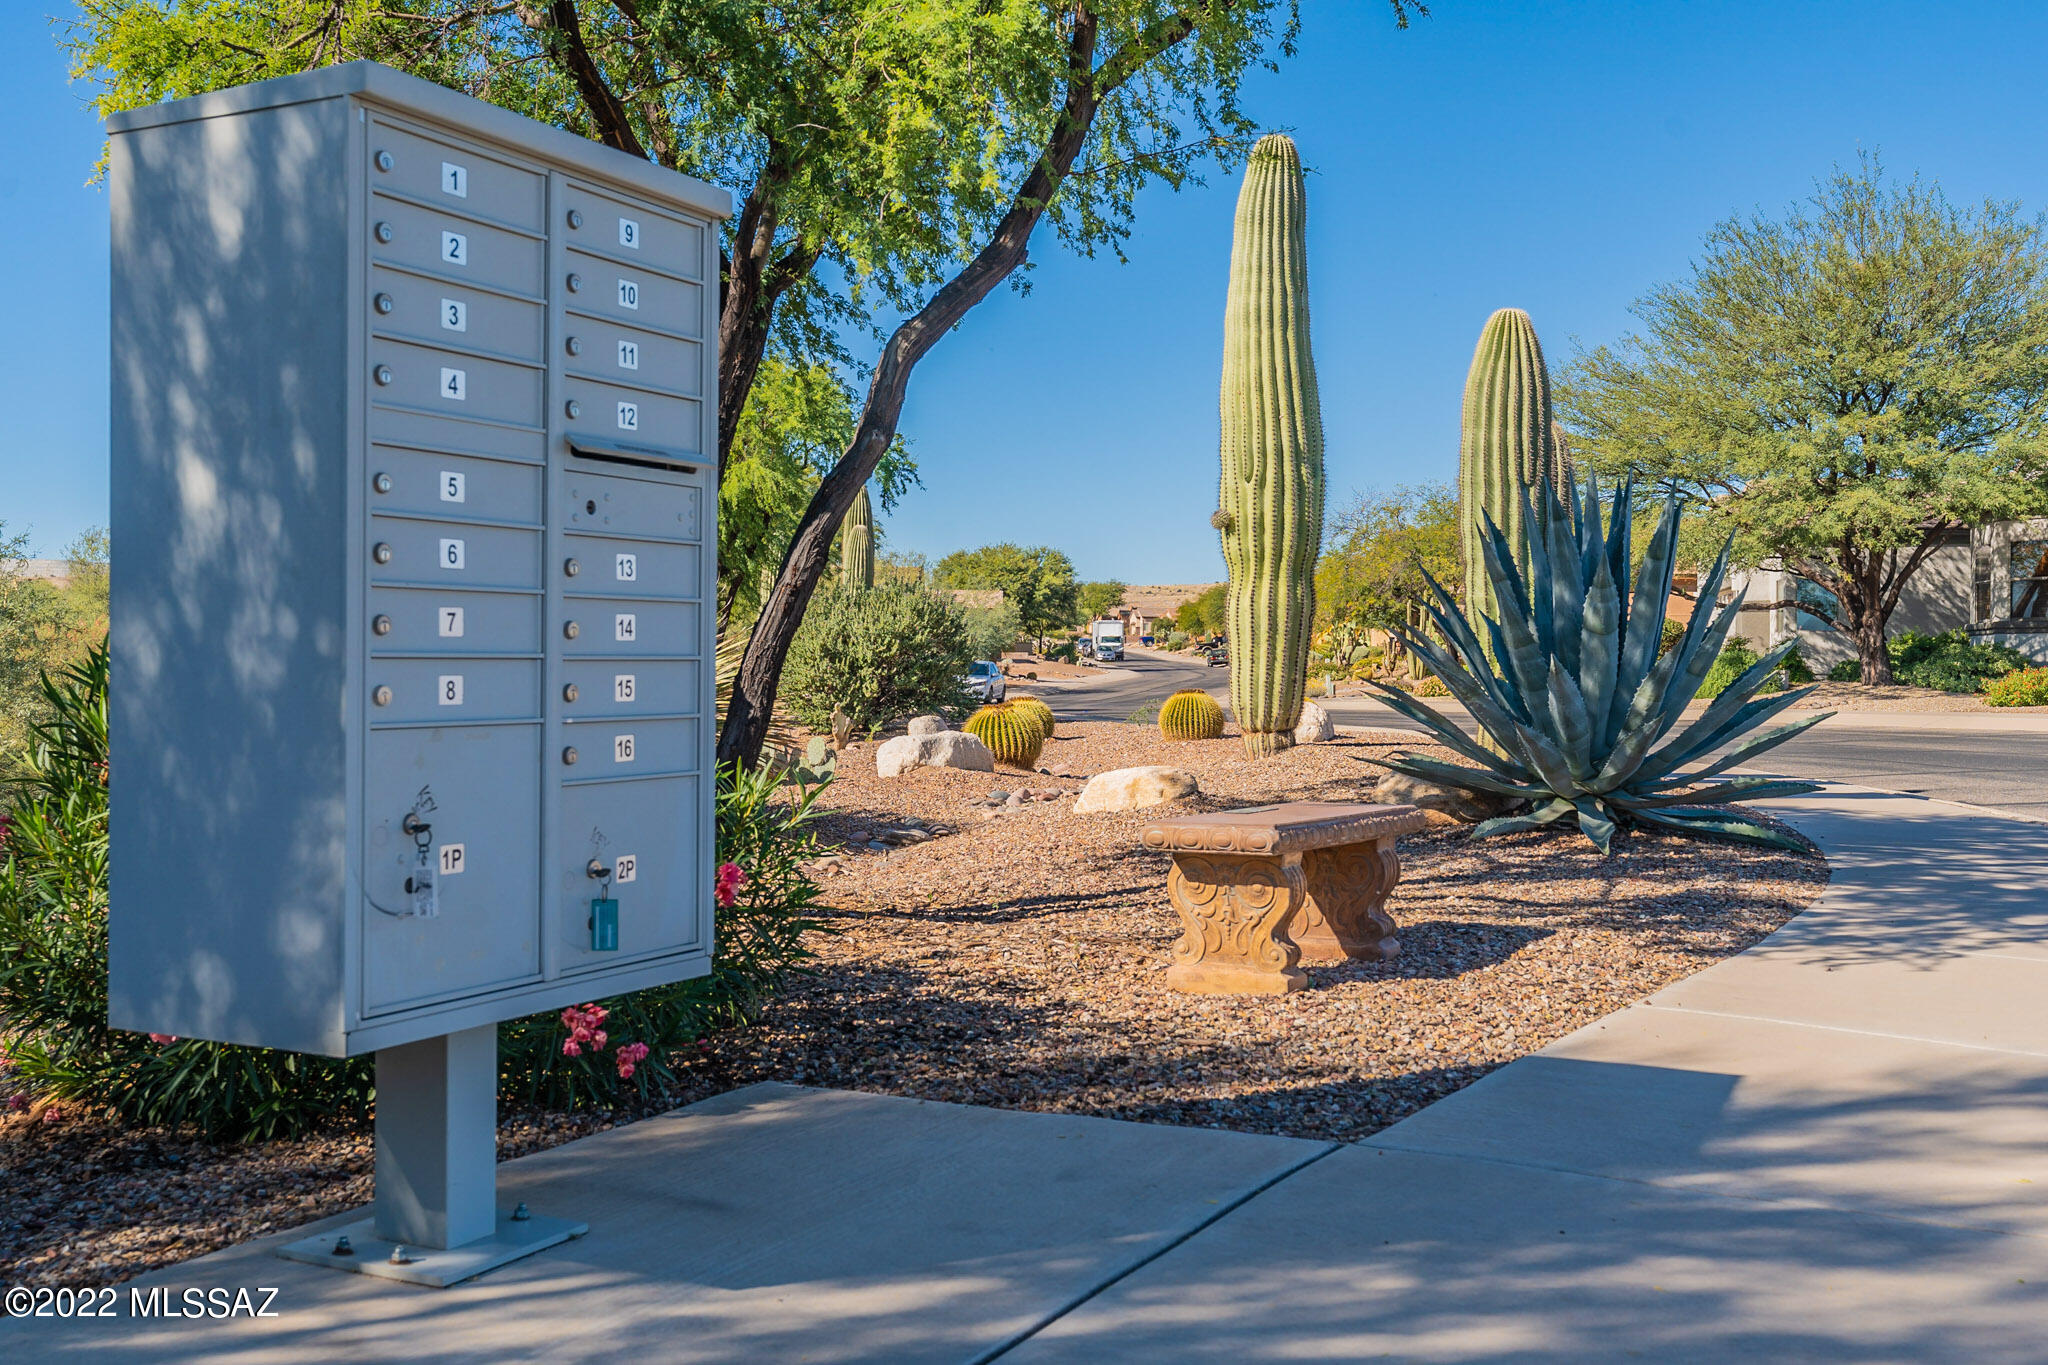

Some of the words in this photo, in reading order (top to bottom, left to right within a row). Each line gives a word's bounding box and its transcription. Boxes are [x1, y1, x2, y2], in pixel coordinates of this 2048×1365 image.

[450, 170, 458, 191] 1
[625, 224, 633, 243] 9
[449, 238, 459, 259] 2
[620, 284, 636, 305] 10
[449, 305, 459, 326] 3
[621, 345, 634, 365] 11
[448, 375, 458, 394] 4
[620, 407, 635, 426] 12
[448, 476, 458, 497] 5
[448, 544, 458, 564] 6
[619, 559, 633, 577] 13
[447, 612, 456, 632] 7
[618, 619, 633, 637] 14
[446, 680, 456, 701] 8
[618, 679, 633, 698] 15
[617, 739, 632, 758] 16
[442, 848, 462, 870] 1P
[618, 860, 634, 880] 2P
